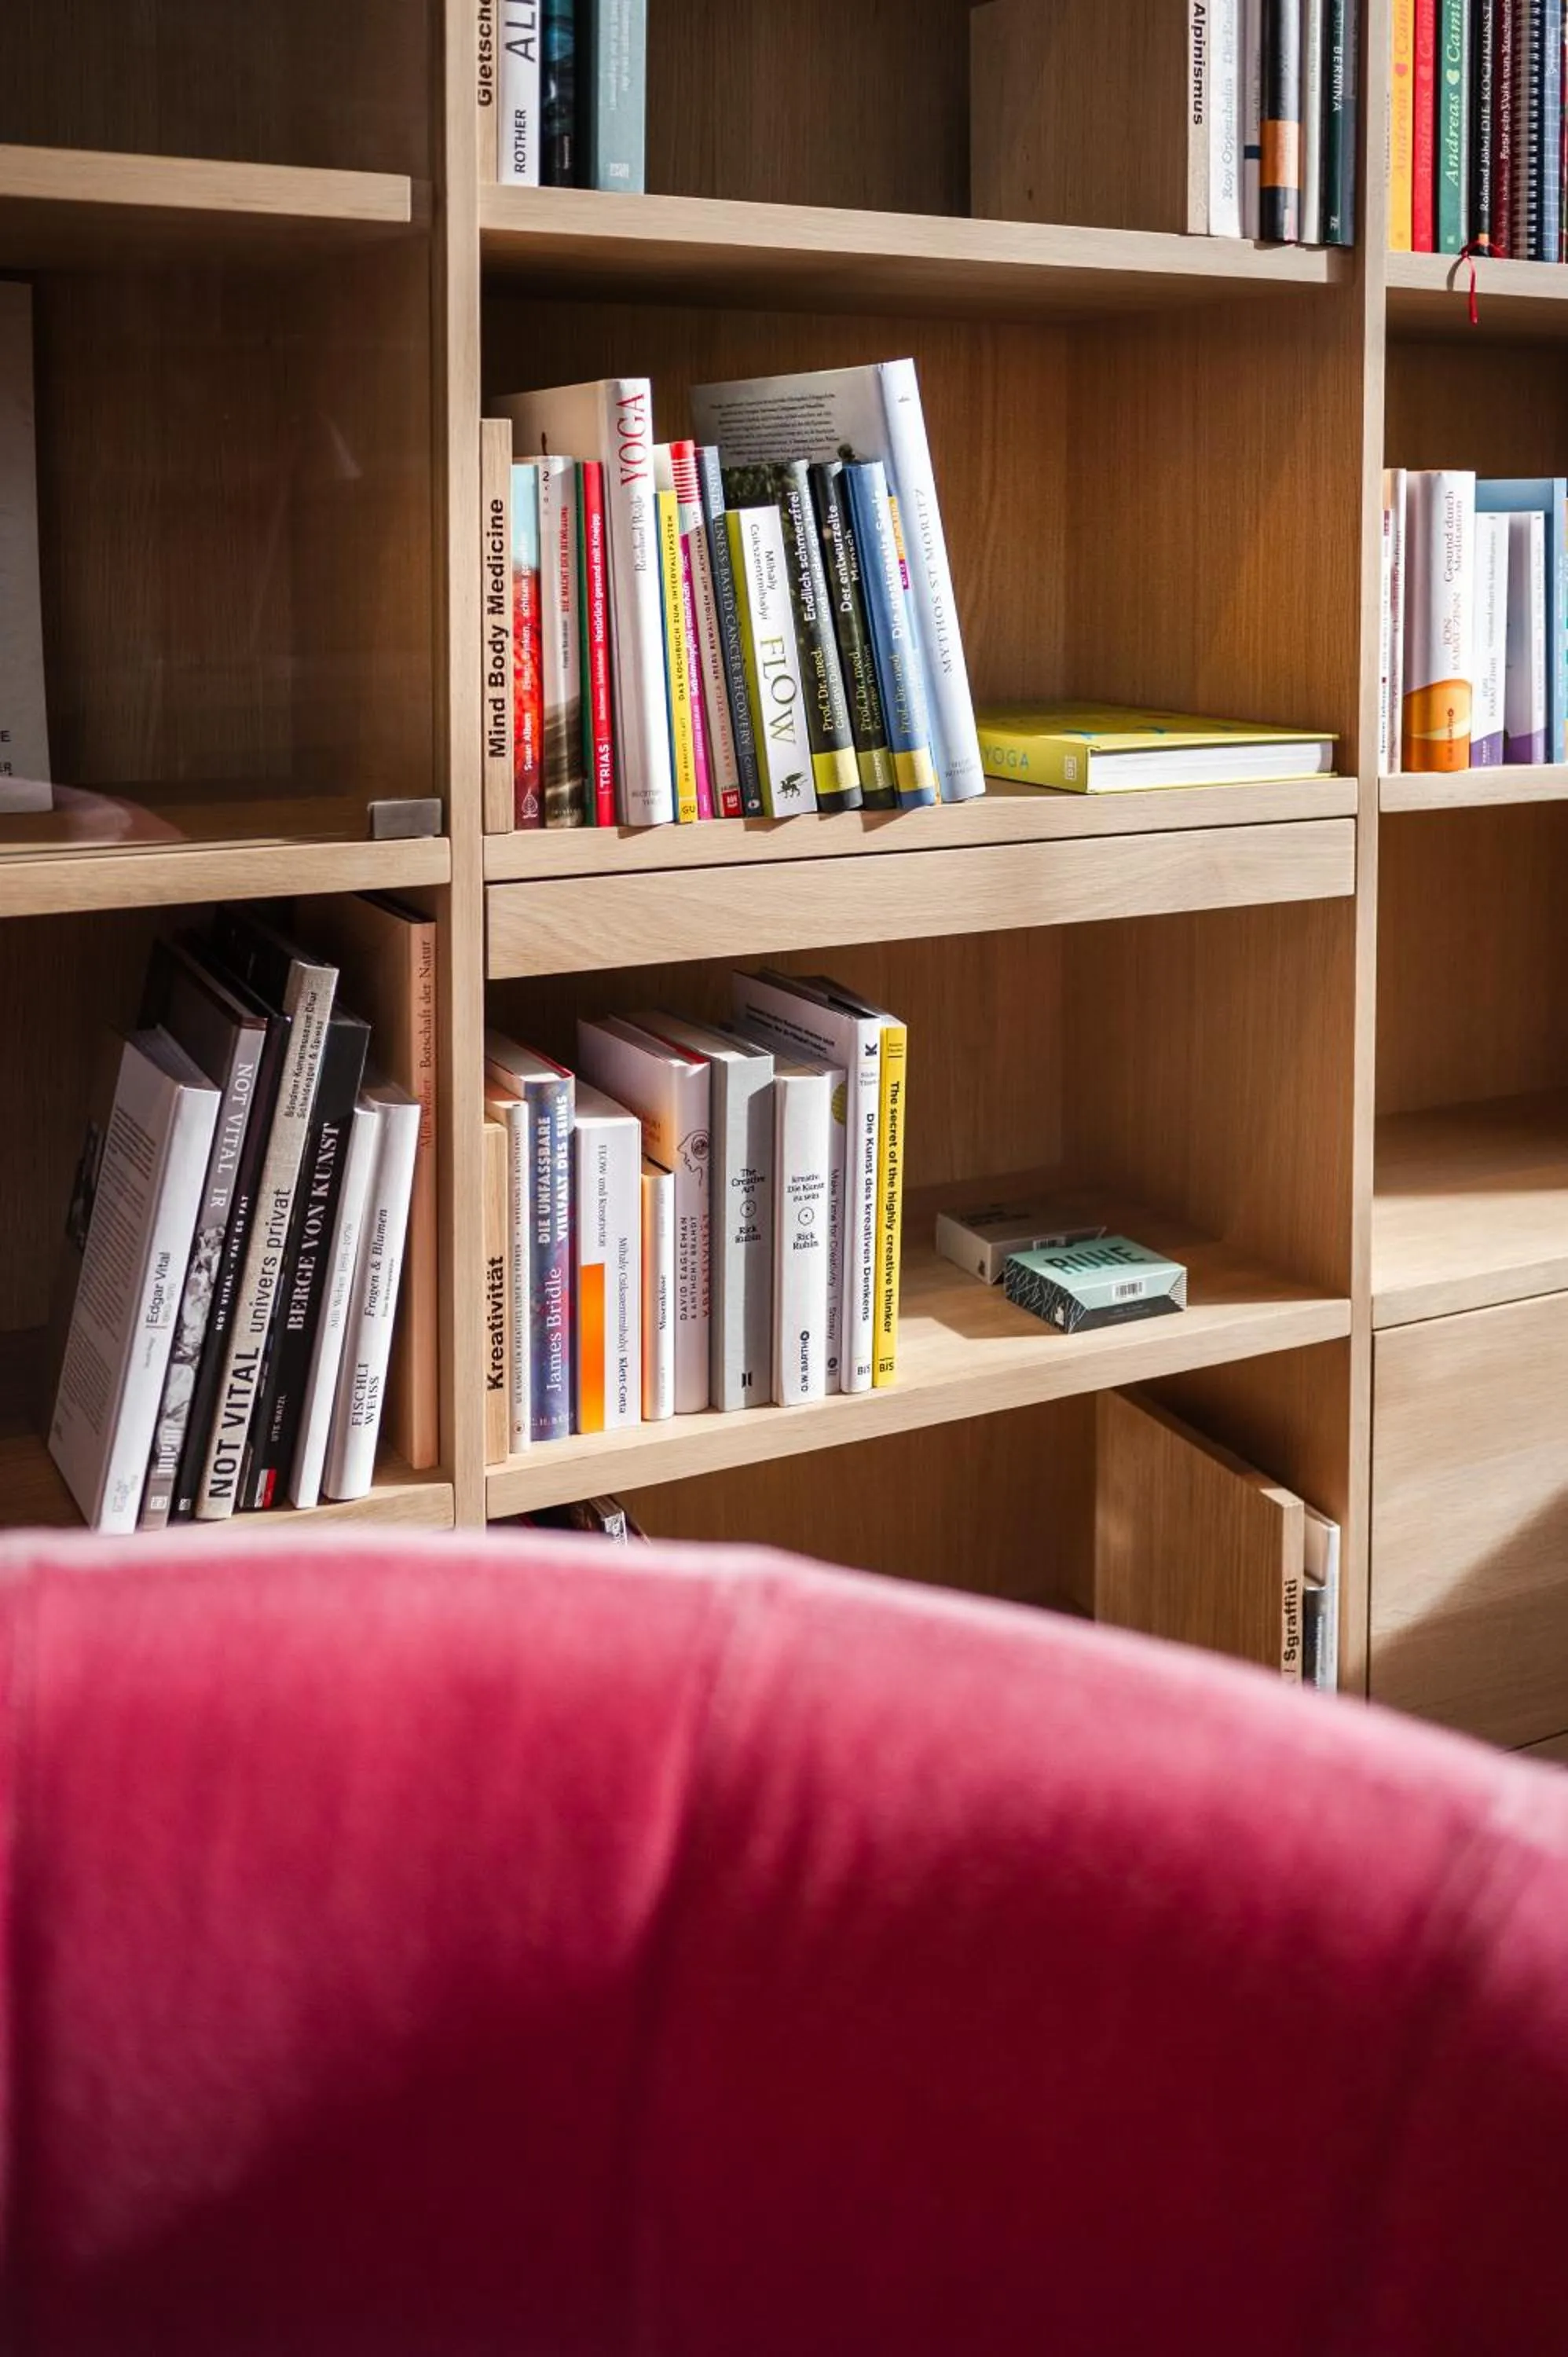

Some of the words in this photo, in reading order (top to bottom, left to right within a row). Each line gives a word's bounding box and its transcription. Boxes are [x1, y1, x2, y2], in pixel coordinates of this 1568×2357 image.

[505, 0, 536, 63] AL
[1482, 4, 1492, 100] KOCHKUNST
[1192, 2, 1207, 125] Alpinismus
[1332, 46, 1344, 112] BERNINA
[1445, 93, 1460, 185] Andreas
[1481, 105, 1491, 131] DIE
[514, 109, 526, 174] ROTHER
[1479, 167, 1491, 211] Roland
[615, 393, 648, 486] YOGA
[591, 513, 603, 546] Kneipp
[786, 491, 808, 568] schmerzfrei
[1443, 491, 1455, 529] durch
[486, 499, 505, 615] Medicine
[592, 547, 601, 563] mit
[826, 504, 848, 585] entwurzelte
[844, 529, 859, 582] Mensch
[1443, 531, 1455, 583] Gesund
[1452, 500, 1463, 573] Meditation
[592, 564, 604, 599] gesund
[811, 548, 826, 596] wieder
[797, 571, 817, 621] Endlich
[815, 596, 830, 621] und
[839, 588, 852, 613] Der
[592, 599, 604, 643] Natürlich
[726, 614, 742, 671] CANCER
[890, 613, 903, 640] Die
[1442, 618, 1453, 646] JON
[487, 625, 509, 688] Body
[674, 628, 683, 680] KOCHBUCH
[811, 647, 826, 677] med.
[677, 682, 686, 701] DAS
[732, 675, 752, 746] RECOVERY
[760, 635, 797, 746] FLOW
[817, 680, 829, 699] Dr.
[855, 680, 867, 699] Dr.
[488, 698, 506, 758] Mind
[821, 702, 833, 731] Prof.
[859, 702, 872, 731] Prof.
[523, 744, 533, 771] Susan
[598, 743, 611, 787] TRIAS
[984, 743, 1030, 768] YOGA
[681, 805, 696, 815] GU
[419, 940, 433, 979] Natur
[419, 983, 432, 1005] der
[291, 1014, 314, 1076] Kunstmuseum
[419, 1009, 433, 1069] Botschaft
[232, 1062, 254, 1105] NOT
[283, 1077, 301, 1118] Bündner
[295, 1061, 318, 1120] Scheidegger
[420, 1078, 432, 1116] Weber
[889, 1080, 900, 1105] The
[556, 1094, 568, 1137] SEINS
[866, 1113, 875, 1135] Die
[888, 1106, 899, 1149] secret
[222, 1113, 245, 1170] VITAL
[307, 1121, 340, 1197] KUNST
[556, 1142, 568, 1170] DES
[865, 1136, 875, 1178] Kunst
[888, 1149, 899, 1164] of
[537, 1116, 551, 1215] UNFASSBARE
[731, 1175, 766, 1187] Creative
[887, 1167, 898, 1189] the
[210, 1187, 228, 1208] IR
[237, 1193, 250, 1215] FAT
[556, 1175, 569, 1242] VIELFALT
[864, 1179, 874, 1200] des
[885, 1190, 898, 1231] highly
[235, 1219, 245, 1233] ES
[265, 1187, 291, 1248] privat
[300, 1203, 326, 1251] VON
[372, 1208, 388, 1257] Blumen
[537, 1219, 551, 1244] DIE
[738, 1226, 757, 1235] Rick
[797, 1232, 815, 1241] Rick
[863, 1203, 874, 1264] kreativen
[153, 1252, 171, 1281] Vital
[229, 1237, 242, 1258] FAT
[370, 1260, 381, 1272] &
[680, 1216, 688, 1281] EAGLEMAN
[793, 1239, 819, 1250] Rubin
[884, 1233, 896, 1286] creative
[146, 1284, 164, 1325] Edgar
[218, 1274, 234, 1305] VITAL
[249, 1255, 277, 1333] univers
[287, 1255, 317, 1330] BERGE
[363, 1274, 383, 1318] Fragen
[544, 1267, 562, 1328] Bridle
[680, 1285, 688, 1321] DAVID
[862, 1266, 872, 1322] Denkens
[883, 1288, 894, 1333] thinker
[214, 1310, 226, 1330] NOT
[486, 1255, 504, 1391] Kreativität
[545, 1332, 562, 1392] James
[878, 1362, 895, 1373] BIS
[220, 1347, 260, 1429] VITAL
[351, 1362, 369, 1428] FISCHLI
[365, 1375, 380, 1425] WEISS
[617, 1356, 628, 1415] Klett-Cotta
[208, 1439, 241, 1499] NOT
[1283, 1578, 1300, 1662] Sgraffiti
